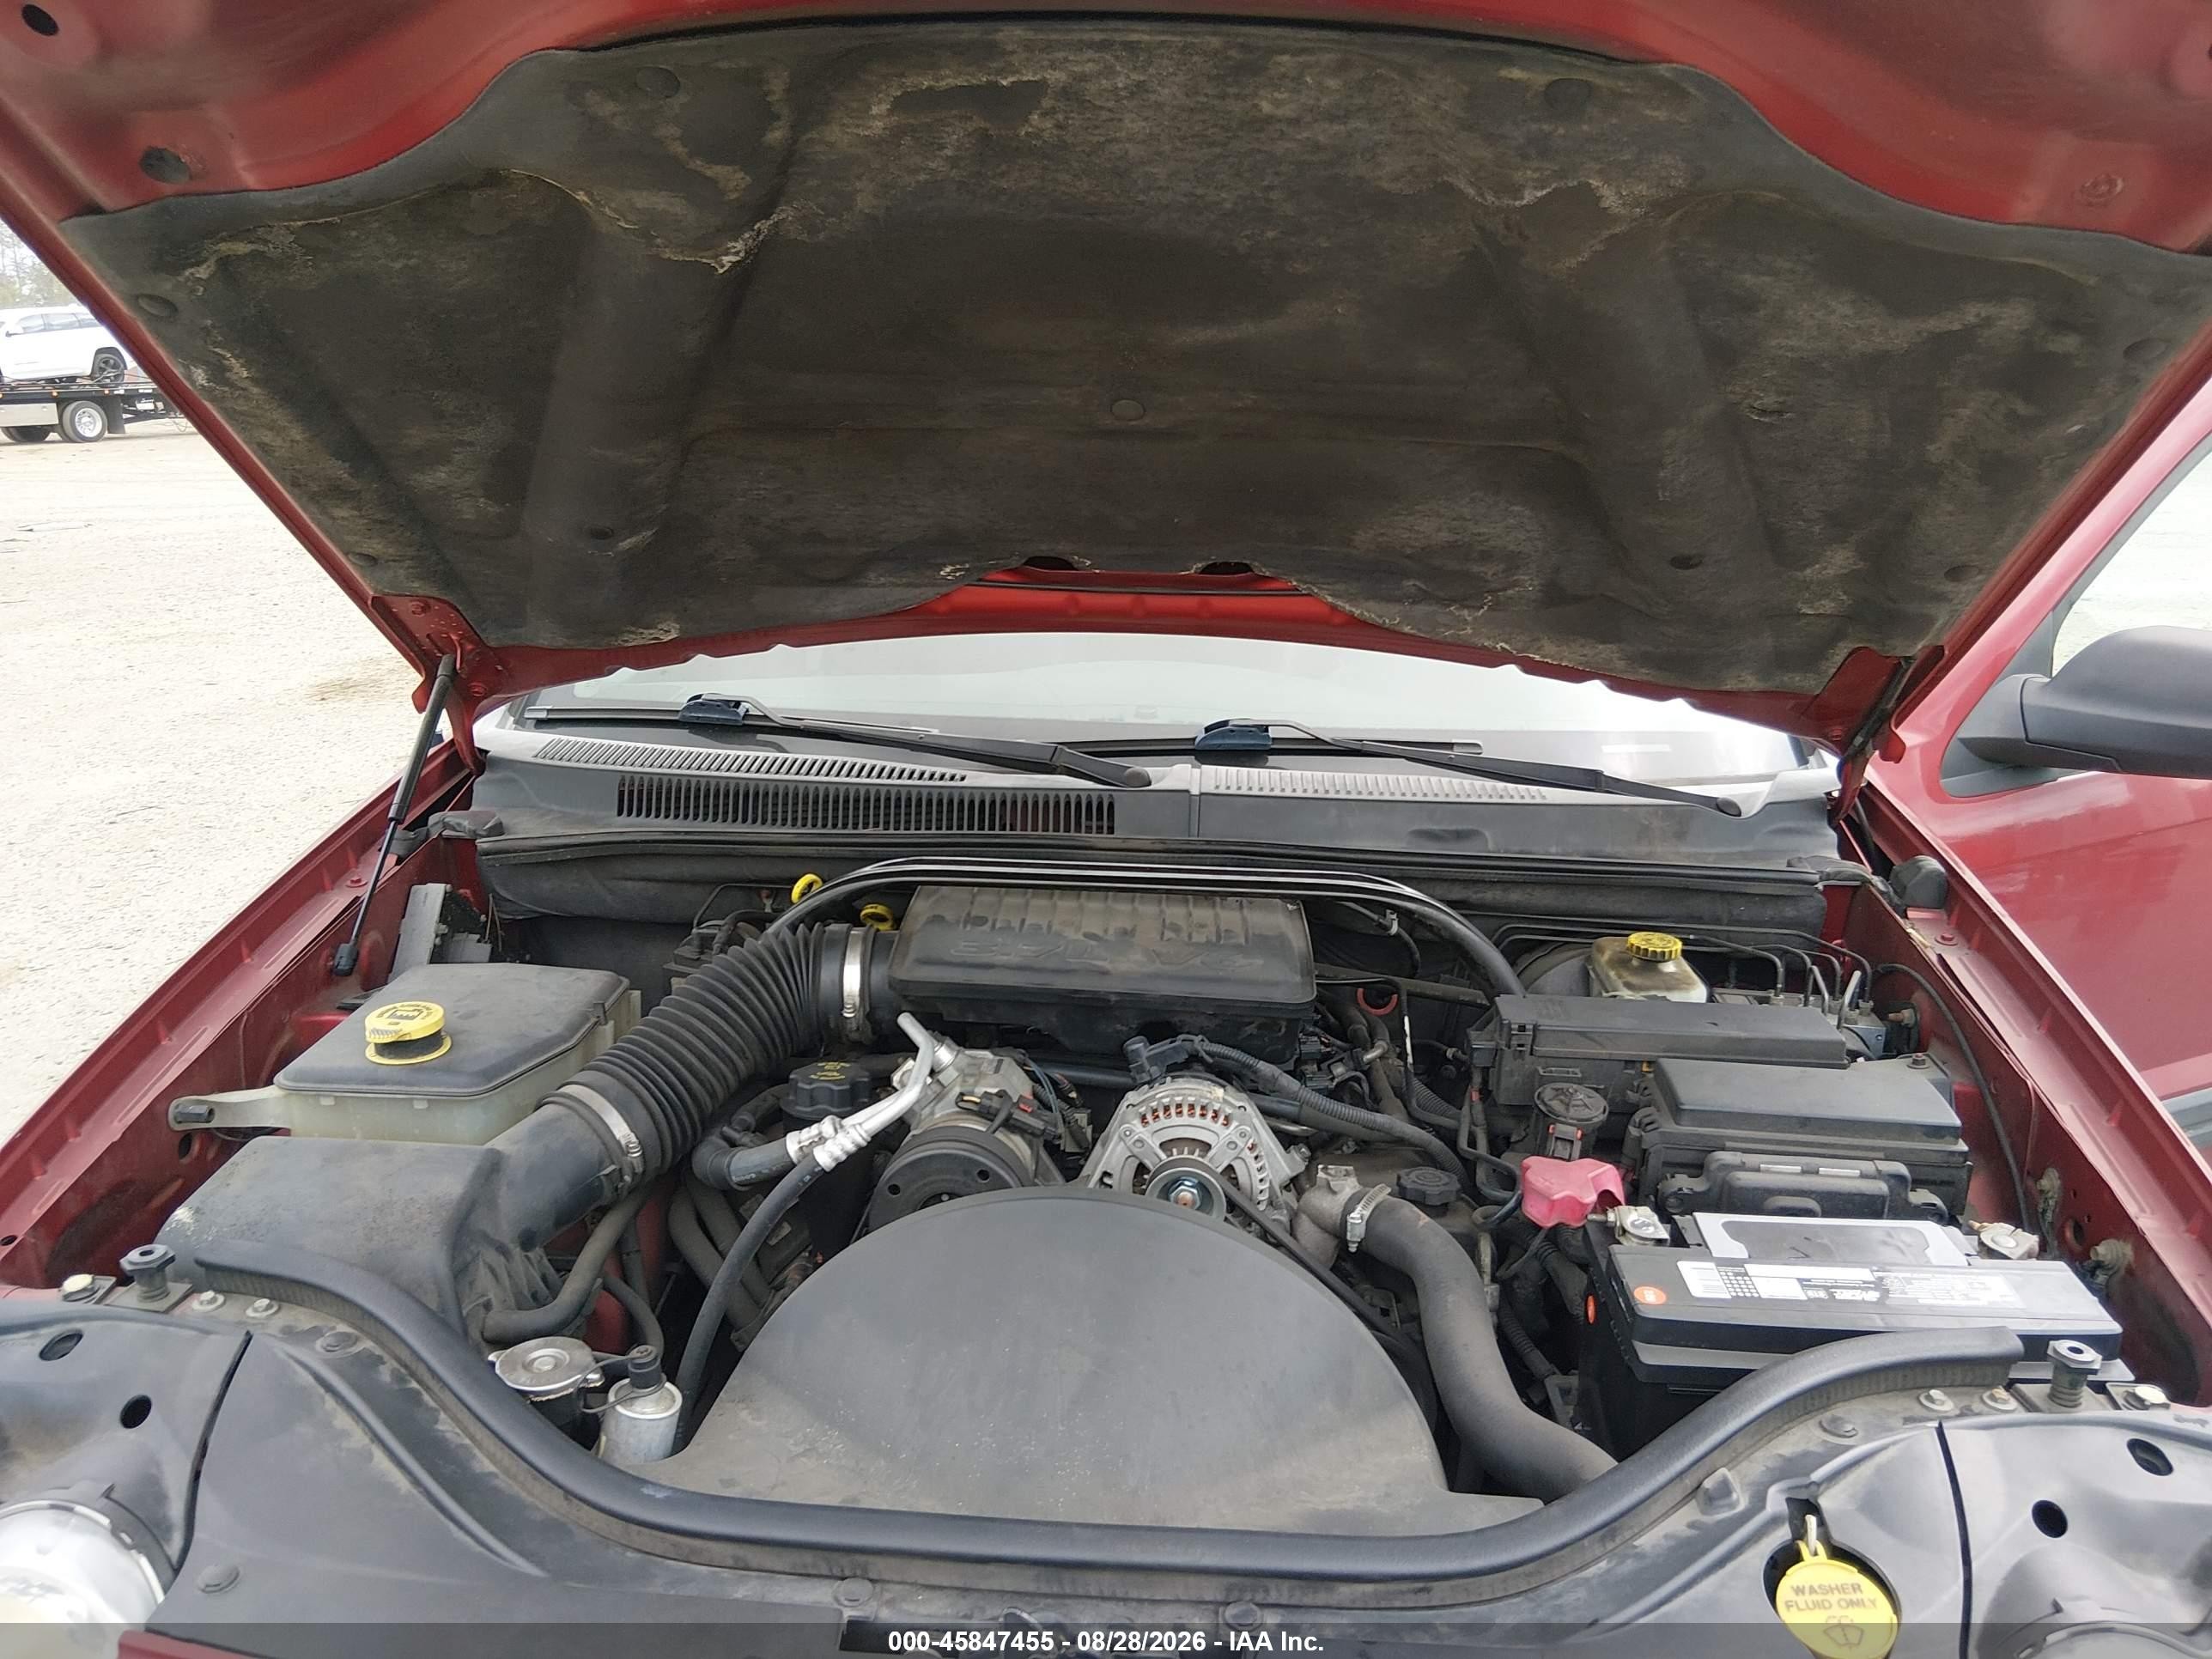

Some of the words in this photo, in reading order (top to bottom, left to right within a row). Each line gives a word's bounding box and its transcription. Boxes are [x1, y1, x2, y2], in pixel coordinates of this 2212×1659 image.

[1790, 1583, 1863, 1596] WASHER
[1784, 1600, 1832, 1612] FLUID
[1838, 1598, 1878, 1610] ONLY
